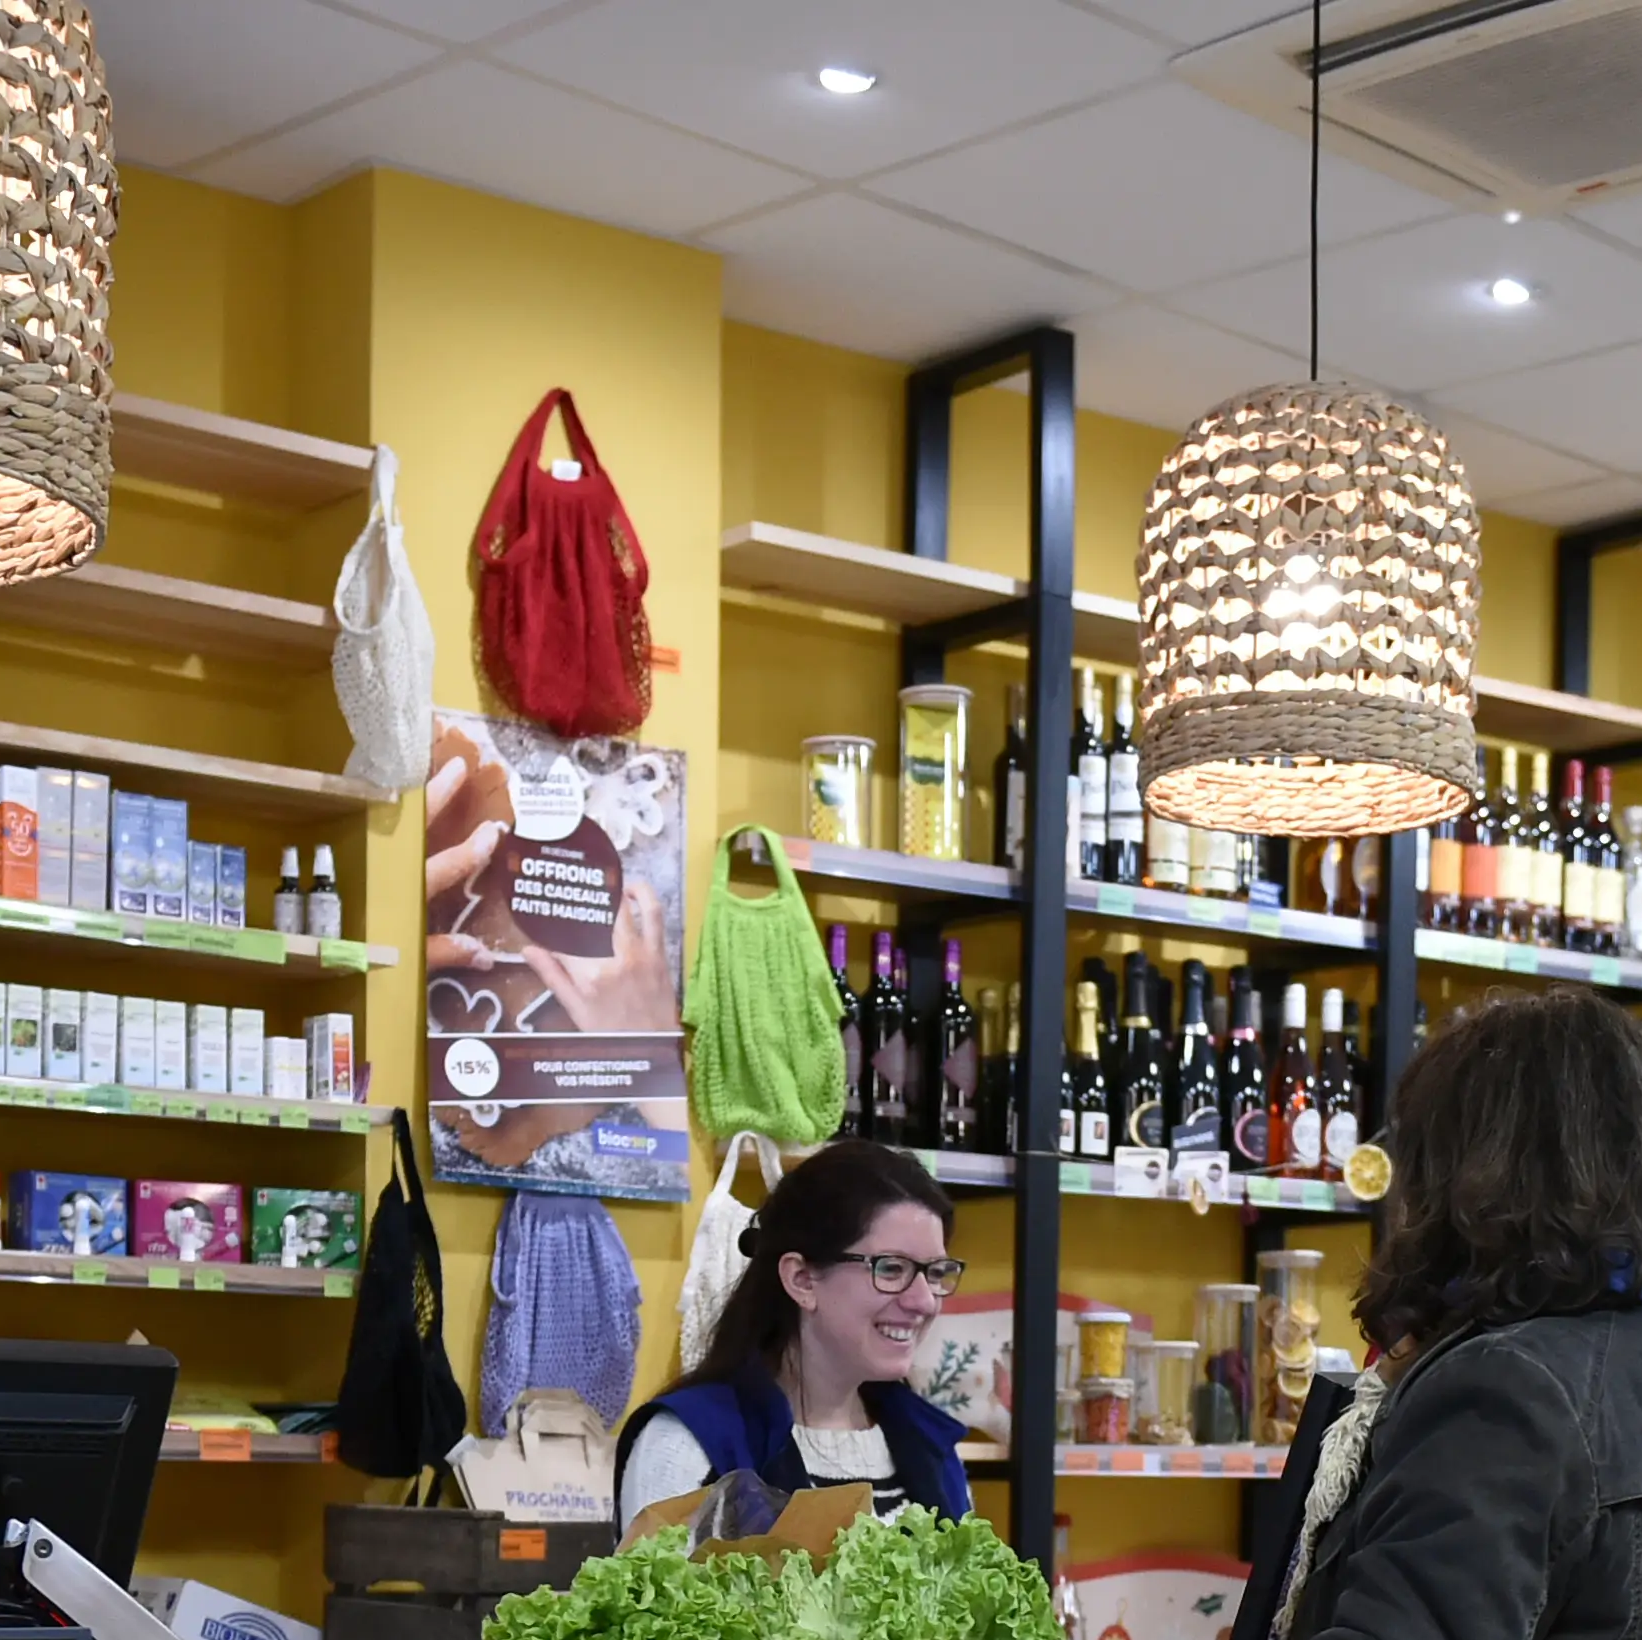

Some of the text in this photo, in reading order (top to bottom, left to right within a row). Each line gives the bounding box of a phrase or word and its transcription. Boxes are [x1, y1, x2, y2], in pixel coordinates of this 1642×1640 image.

[520, 857, 605, 887] OFFRONS
[514, 878, 611, 906] DES CADEAUX
[511, 896, 551, 917] FAITS
[552, 902, 607, 925] MAISON
[533, 1060, 563, 1073] POUR
[505, 1490, 598, 1511] PROCHAINE
